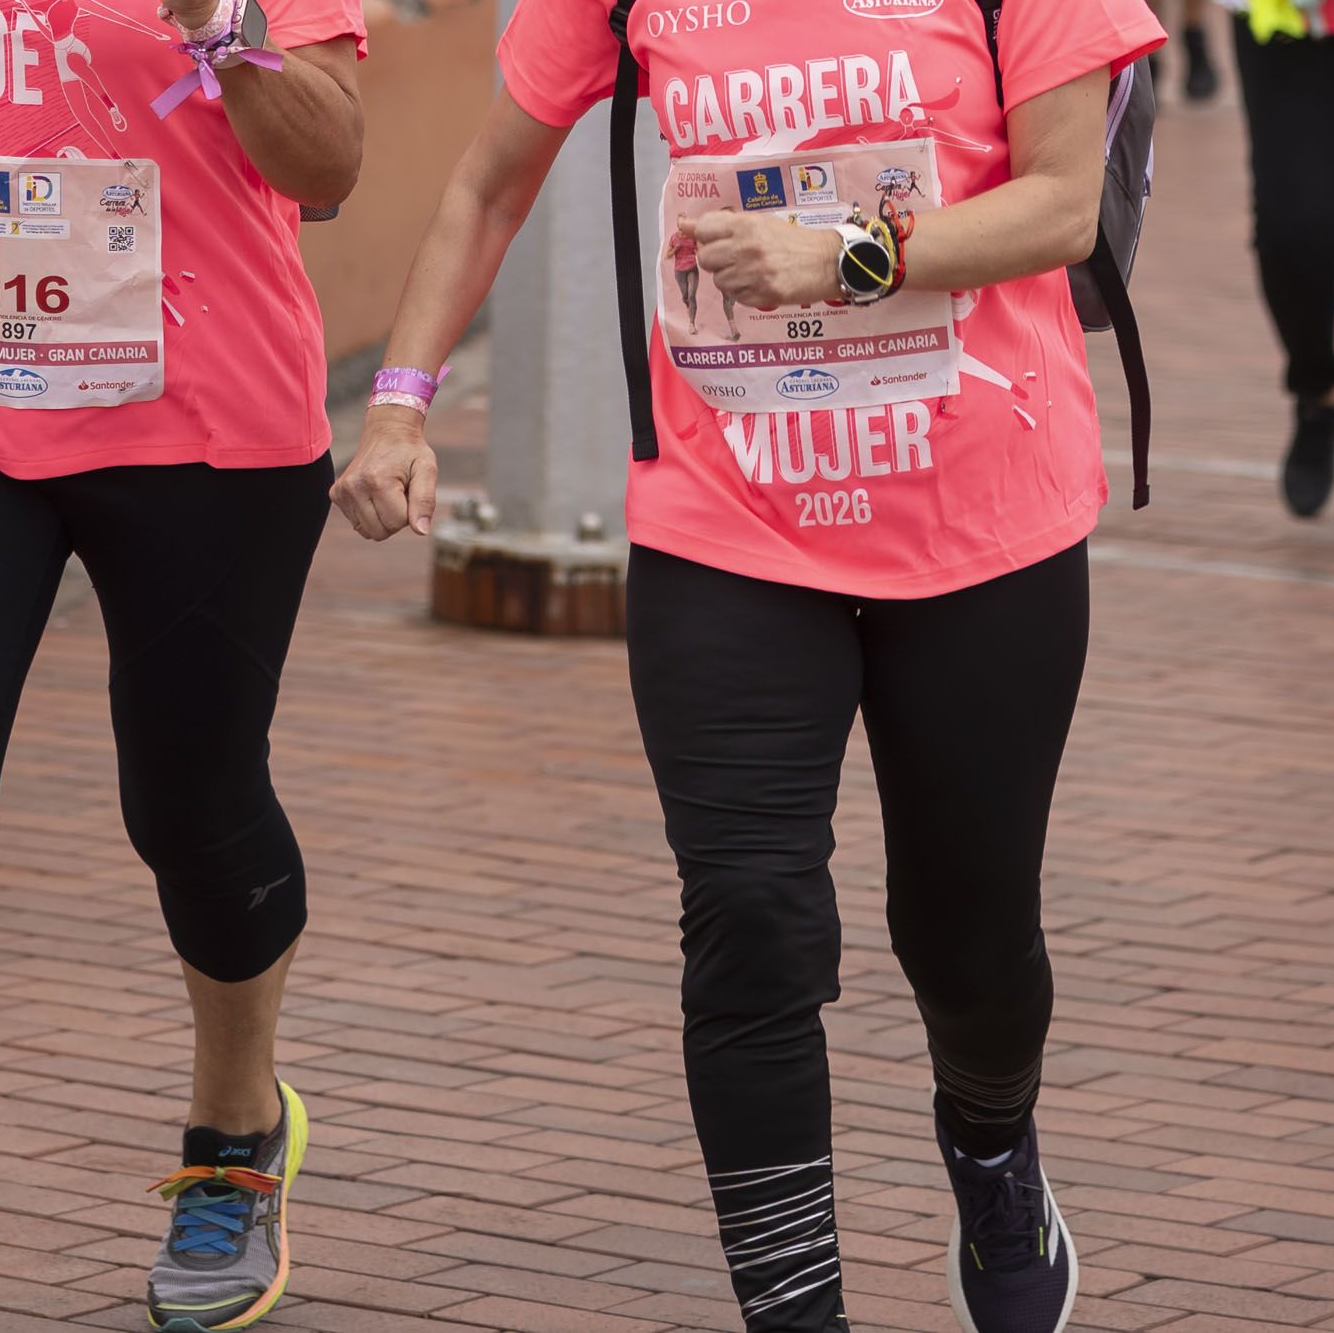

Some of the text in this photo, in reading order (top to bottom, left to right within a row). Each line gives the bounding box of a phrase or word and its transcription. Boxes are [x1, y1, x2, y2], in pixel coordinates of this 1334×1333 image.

[647, 0, 752, 38] OYSHO
[665, 49, 927, 149] CARRERA
[686, 172, 718, 182] DORSAL
[677, 182, 721, 198] SUMA
[745, 201, 760, 209] Gran
[749, 313, 779, 321] TELÉFONO
[822, 309, 848, 317] GÉNERO
[2, 322, 37, 340] 897
[787, 319, 824, 339] 892
[48, 348, 85, 362] GRAN
[88, 346, 148, 360] CANARIA
[678, 333, 939, 365] CARRERA DE LA MUJER GRAN CANARIA
[90, 380, 135, 391] Santander
[882, 372, 928, 385] Santander
[702, 385, 746, 397] OYSHO
[781, 382, 835, 393] ASTURIANA
[723, 401, 934, 485] MUJER
[795, 487, 873, 528] 2026
